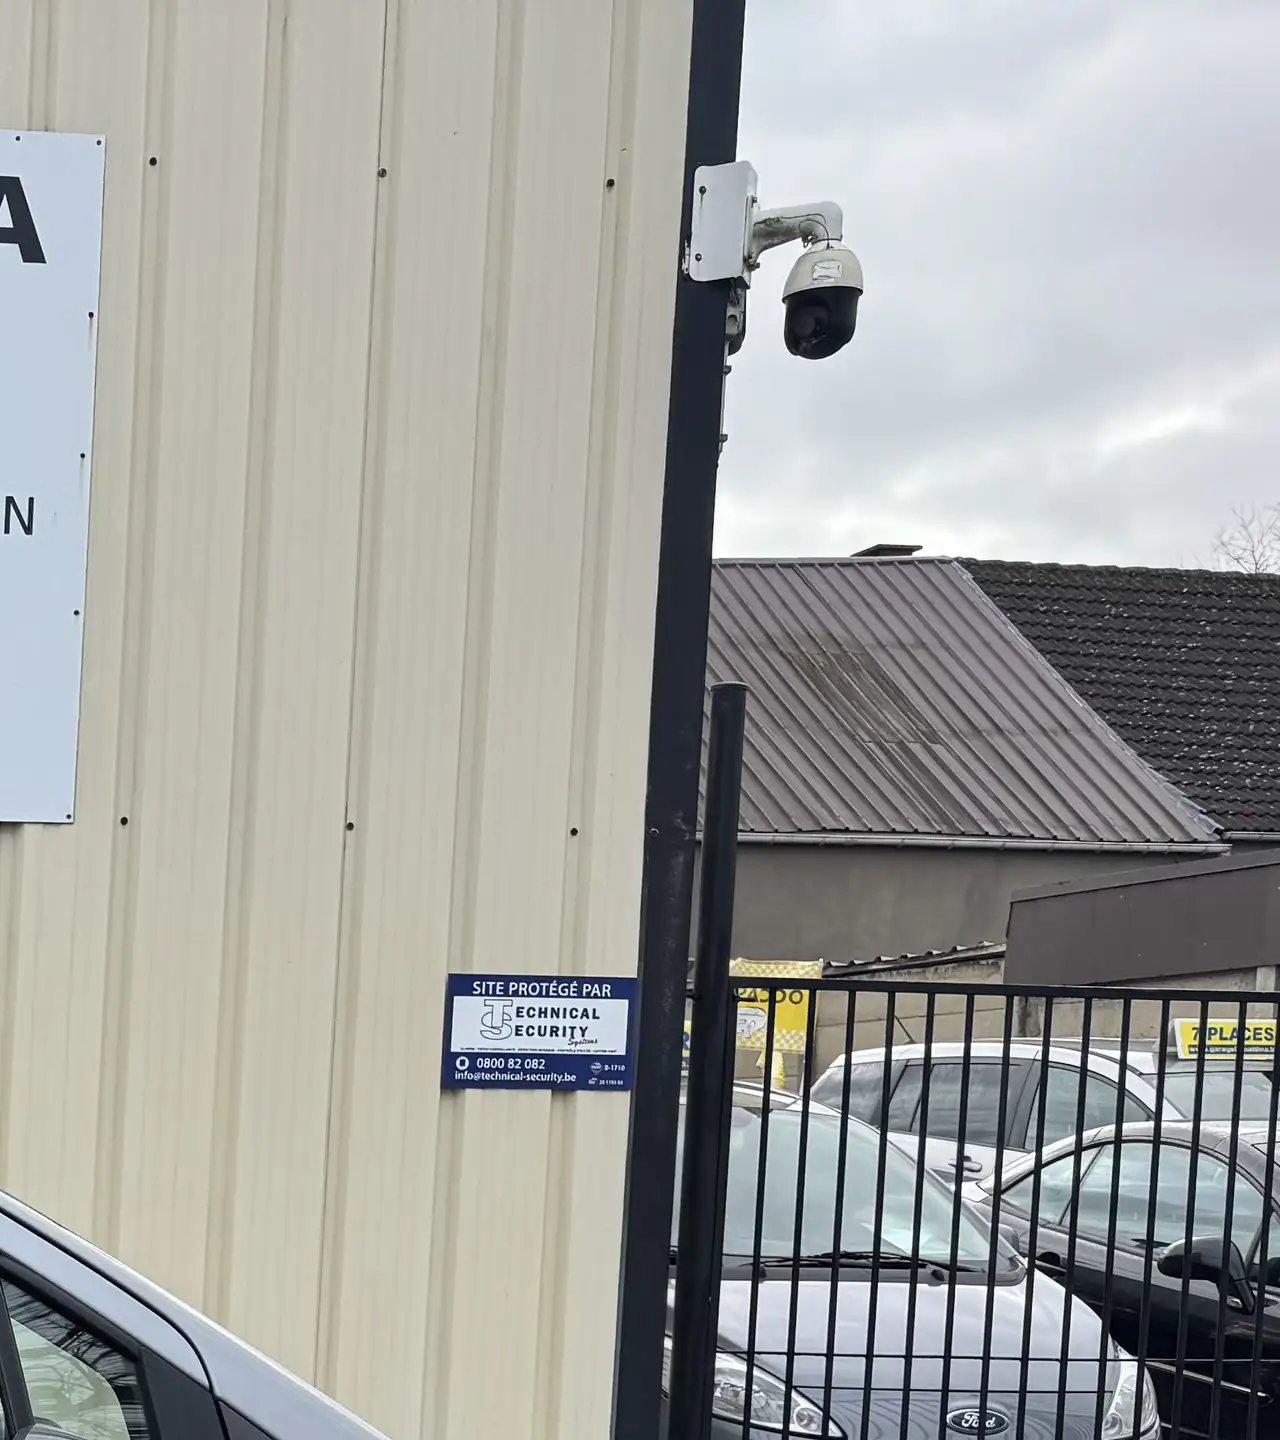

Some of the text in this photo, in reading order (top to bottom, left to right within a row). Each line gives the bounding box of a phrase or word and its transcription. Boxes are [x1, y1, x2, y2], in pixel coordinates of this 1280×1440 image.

[472, 980, 611, 997] SITE PROTÉGÉ PAR
[476, 1058, 546, 1070] 0800 82 082
[454, 1070, 577, 1084] info@technical-security.be
[961, 1412, 996, 1428] Fod
